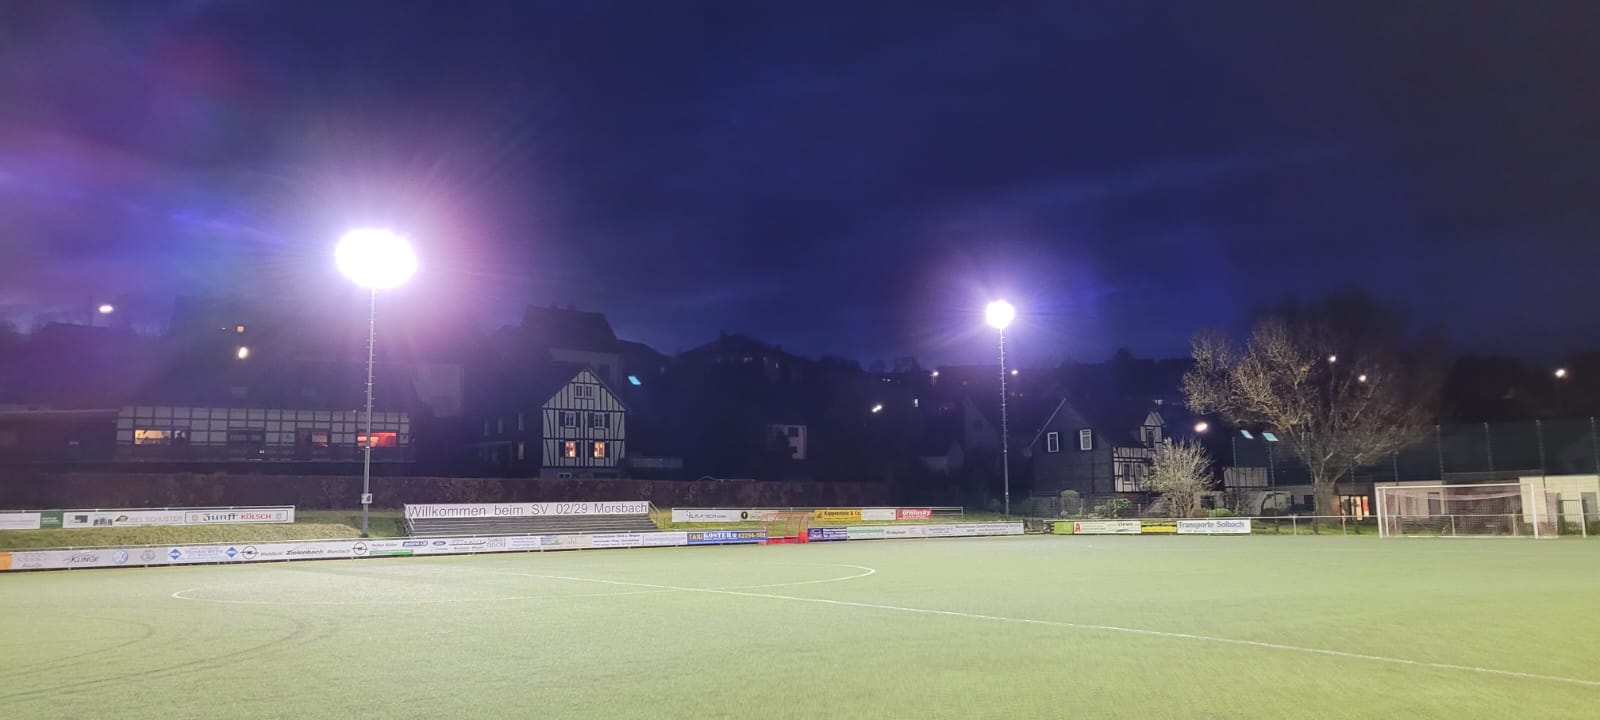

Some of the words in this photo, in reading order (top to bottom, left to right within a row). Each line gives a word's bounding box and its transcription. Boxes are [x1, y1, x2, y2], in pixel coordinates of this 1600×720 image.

[408, 505, 486, 518] Willkommen
[494, 504, 524, 517] beim
[531, 503, 549, 515] SV
[556, 503, 588, 514] 02/29
[594, 502, 648, 514] Morsbach
[1216, 520, 1245, 528] Solbach
